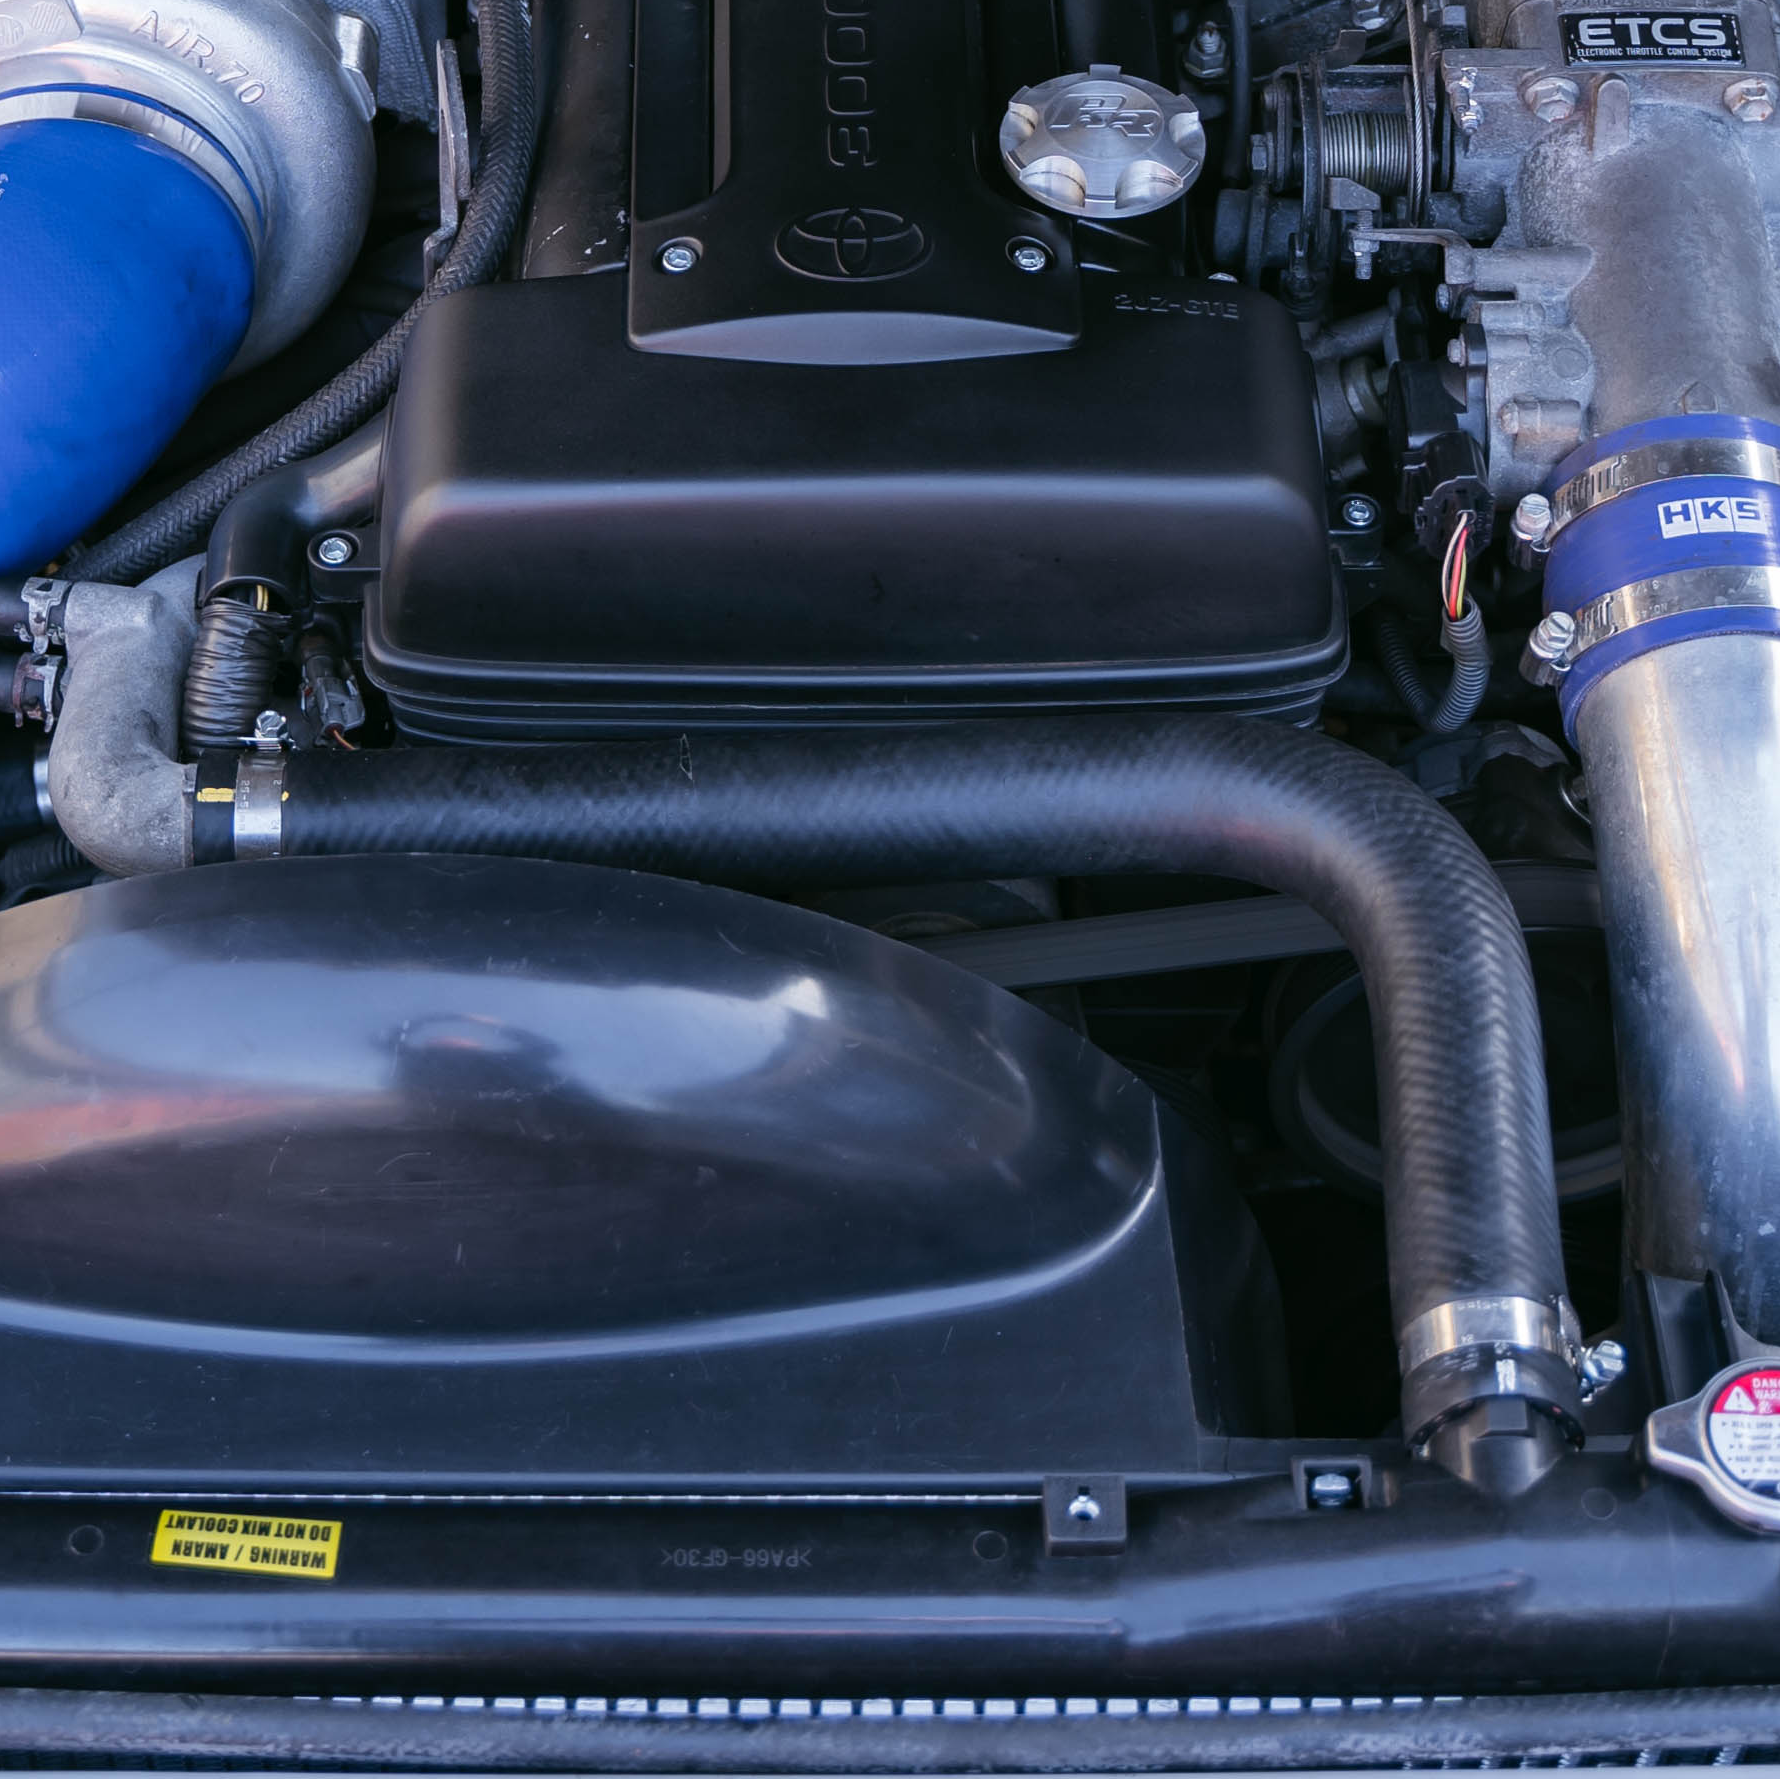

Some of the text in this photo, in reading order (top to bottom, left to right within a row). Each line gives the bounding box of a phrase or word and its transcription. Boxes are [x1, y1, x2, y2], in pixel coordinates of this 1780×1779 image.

[1577, 17, 1727, 47] ETCS
[1576, 47, 1733, 58] ELECTRONIC THROTTLE CONTROL SYSTEM
[1113, 293, 1239, 319] 2JZ-GTE
[1661, 499, 1763, 528] HKS
[165, 1514, 332, 1542] DO NOT MIX COOLANT
[171, 1539, 231, 1561] AMARN
[249, 1545, 327, 1569] WARNING
